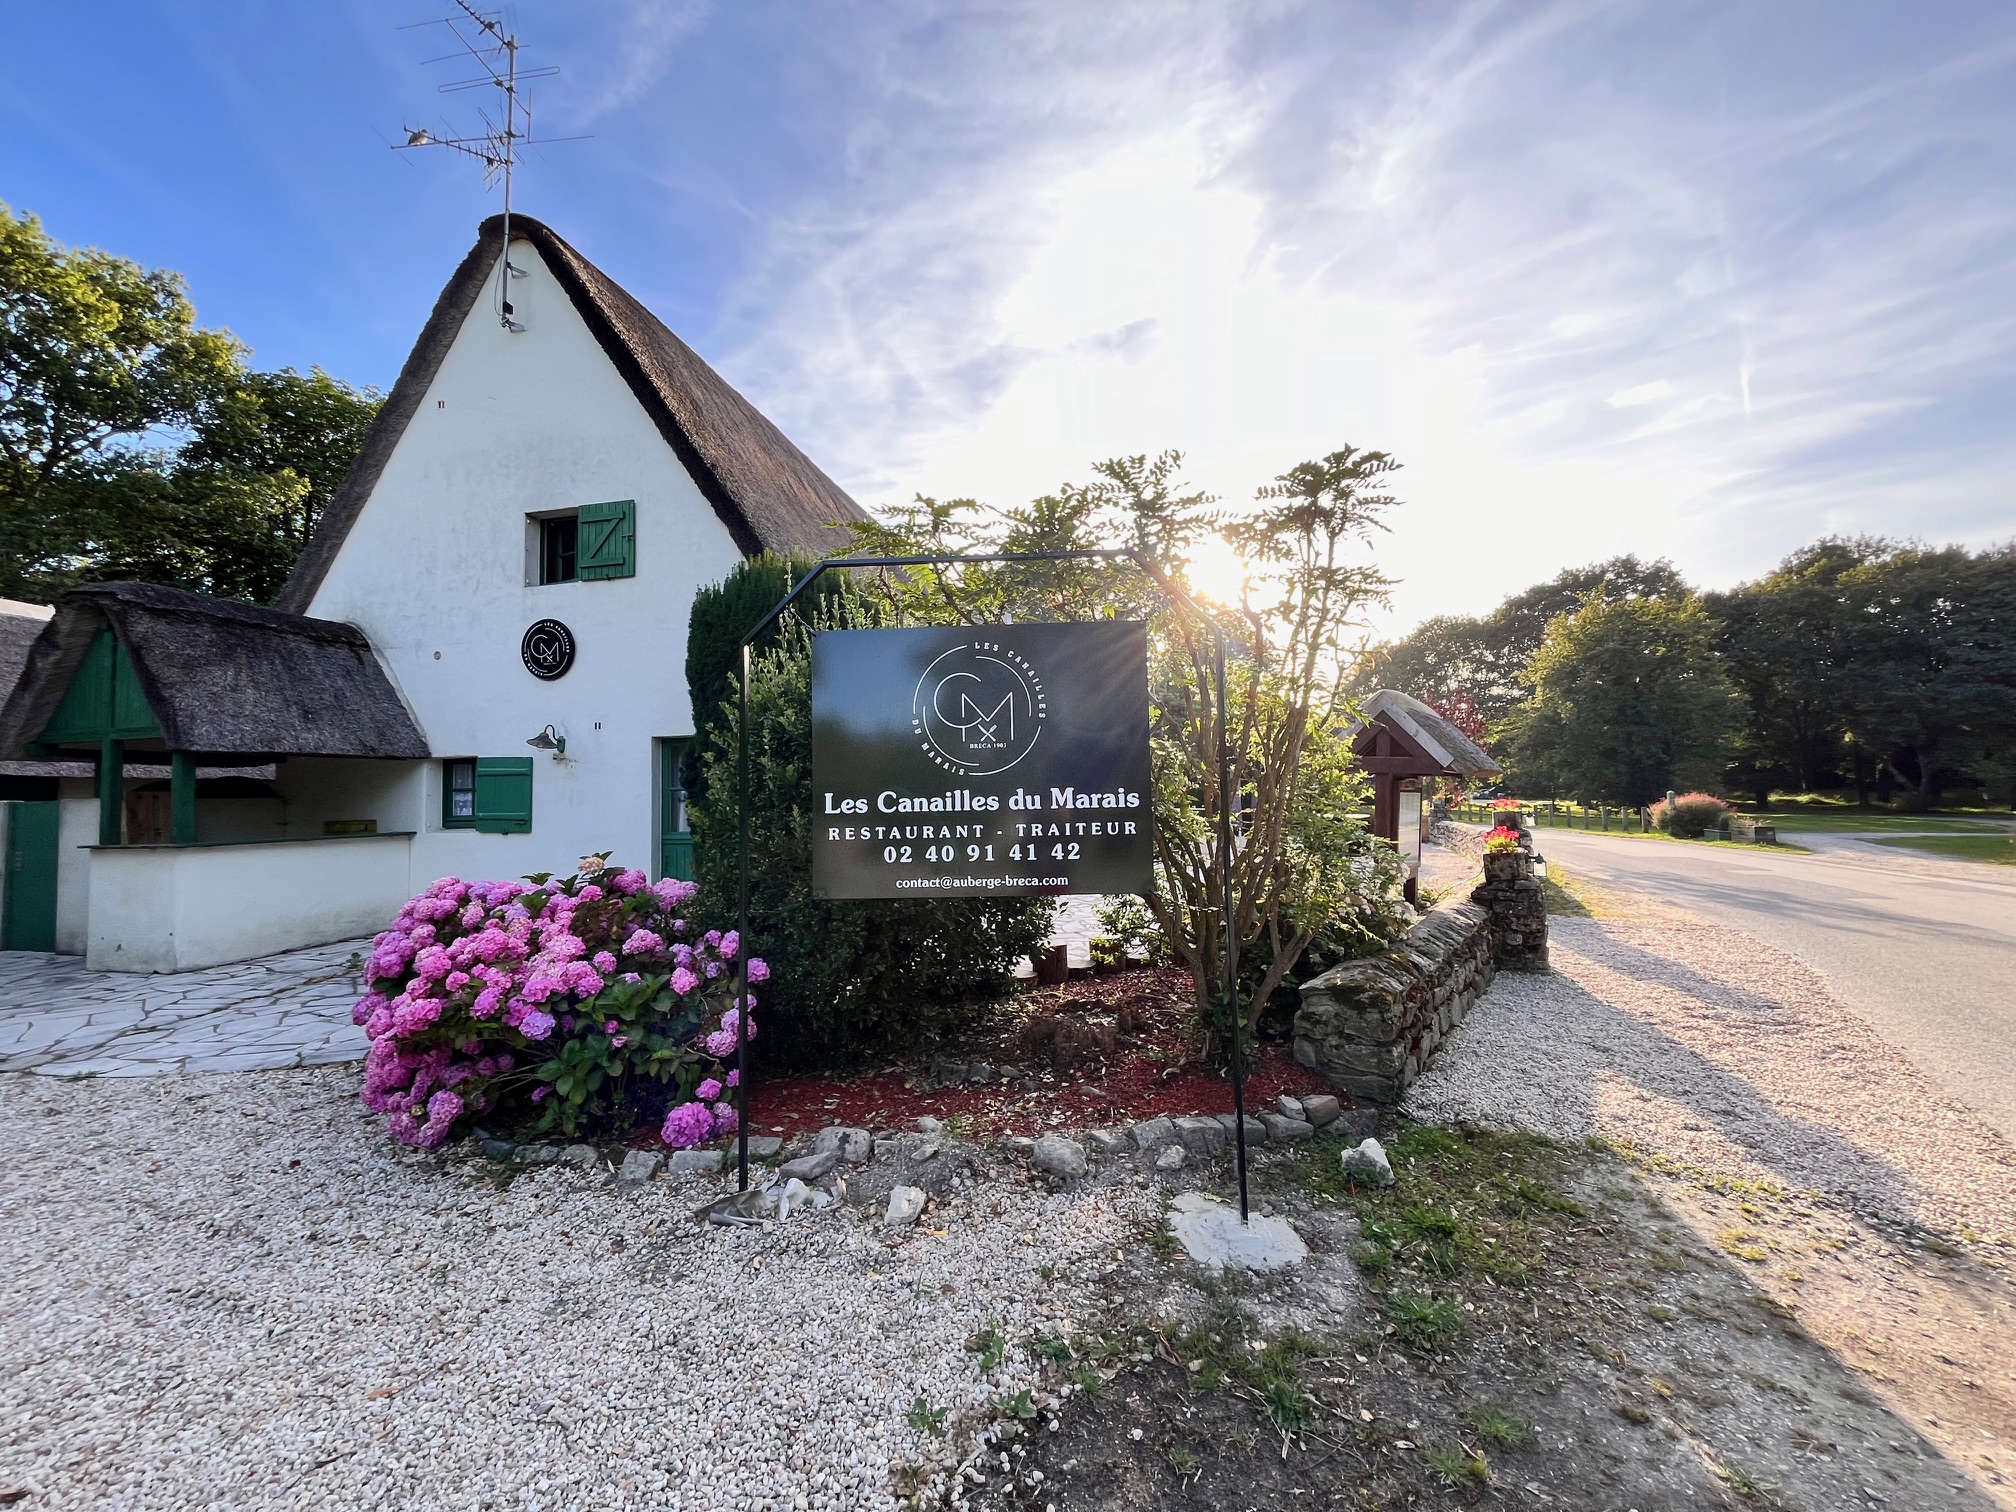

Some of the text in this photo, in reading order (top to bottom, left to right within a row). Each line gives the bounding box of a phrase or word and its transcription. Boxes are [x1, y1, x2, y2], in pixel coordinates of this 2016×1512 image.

[974, 642, 1047, 719] LES CANAILLES
[912, 719, 965, 776] DU MARAIS
[824, 787, 1140, 815] Les Canailles du Marais
[829, 825, 985, 841] RESTAURANT
[1016, 821, 1137, 837] TRAITEUR
[884, 843, 1080, 863] 02 40 91 41 42
[896, 875, 1068, 890] contact@auberge-breca.com
